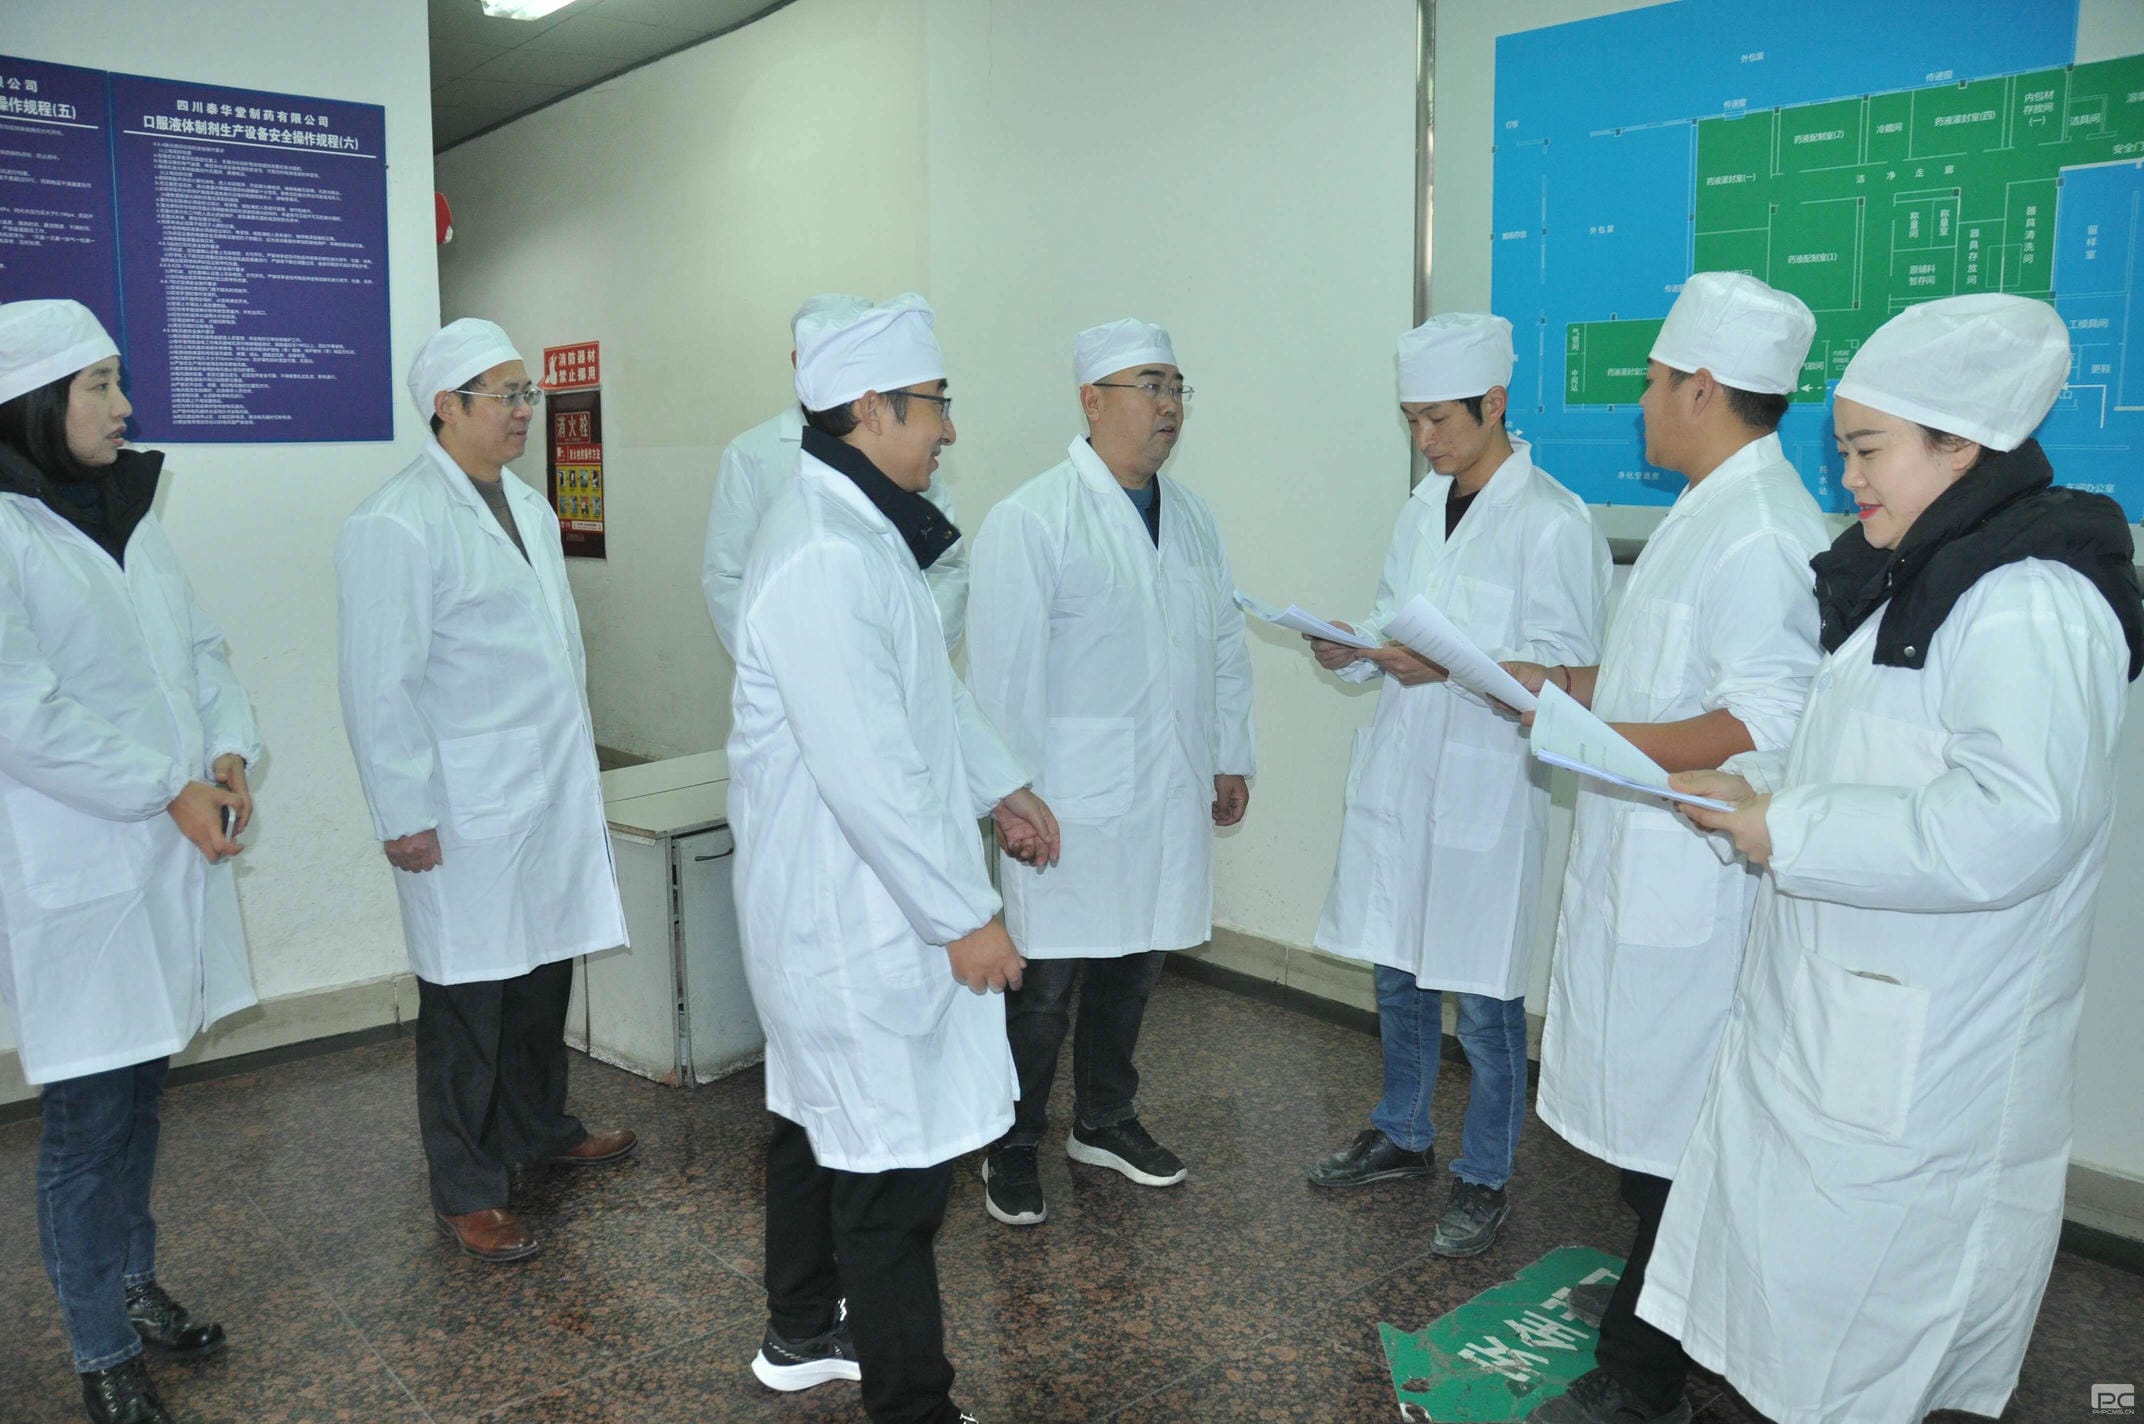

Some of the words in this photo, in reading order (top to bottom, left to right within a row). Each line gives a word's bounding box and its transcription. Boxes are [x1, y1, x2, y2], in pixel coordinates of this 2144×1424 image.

[2024, 89, 2055, 103] 内包材
[176, 99, 330, 129] 四川泰华堂制药有限公司
[2023, 102, 2055, 115] 存放间
[1934, 110, 1995, 127] 药液灌封室(四)
[2069, 112, 2101, 126] 洁具间
[143, 114, 359, 151] 口服液体制剂生产设备安全操作规程(六)
[2022, 206, 2037, 264] 器具清洗间
[1966, 228, 1980, 285] 器具存放间
[558, 349, 595, 367] 消防器材
[559, 366, 596, 384] 禁止挪用
[557, 414, 588, 438] 消火栓
